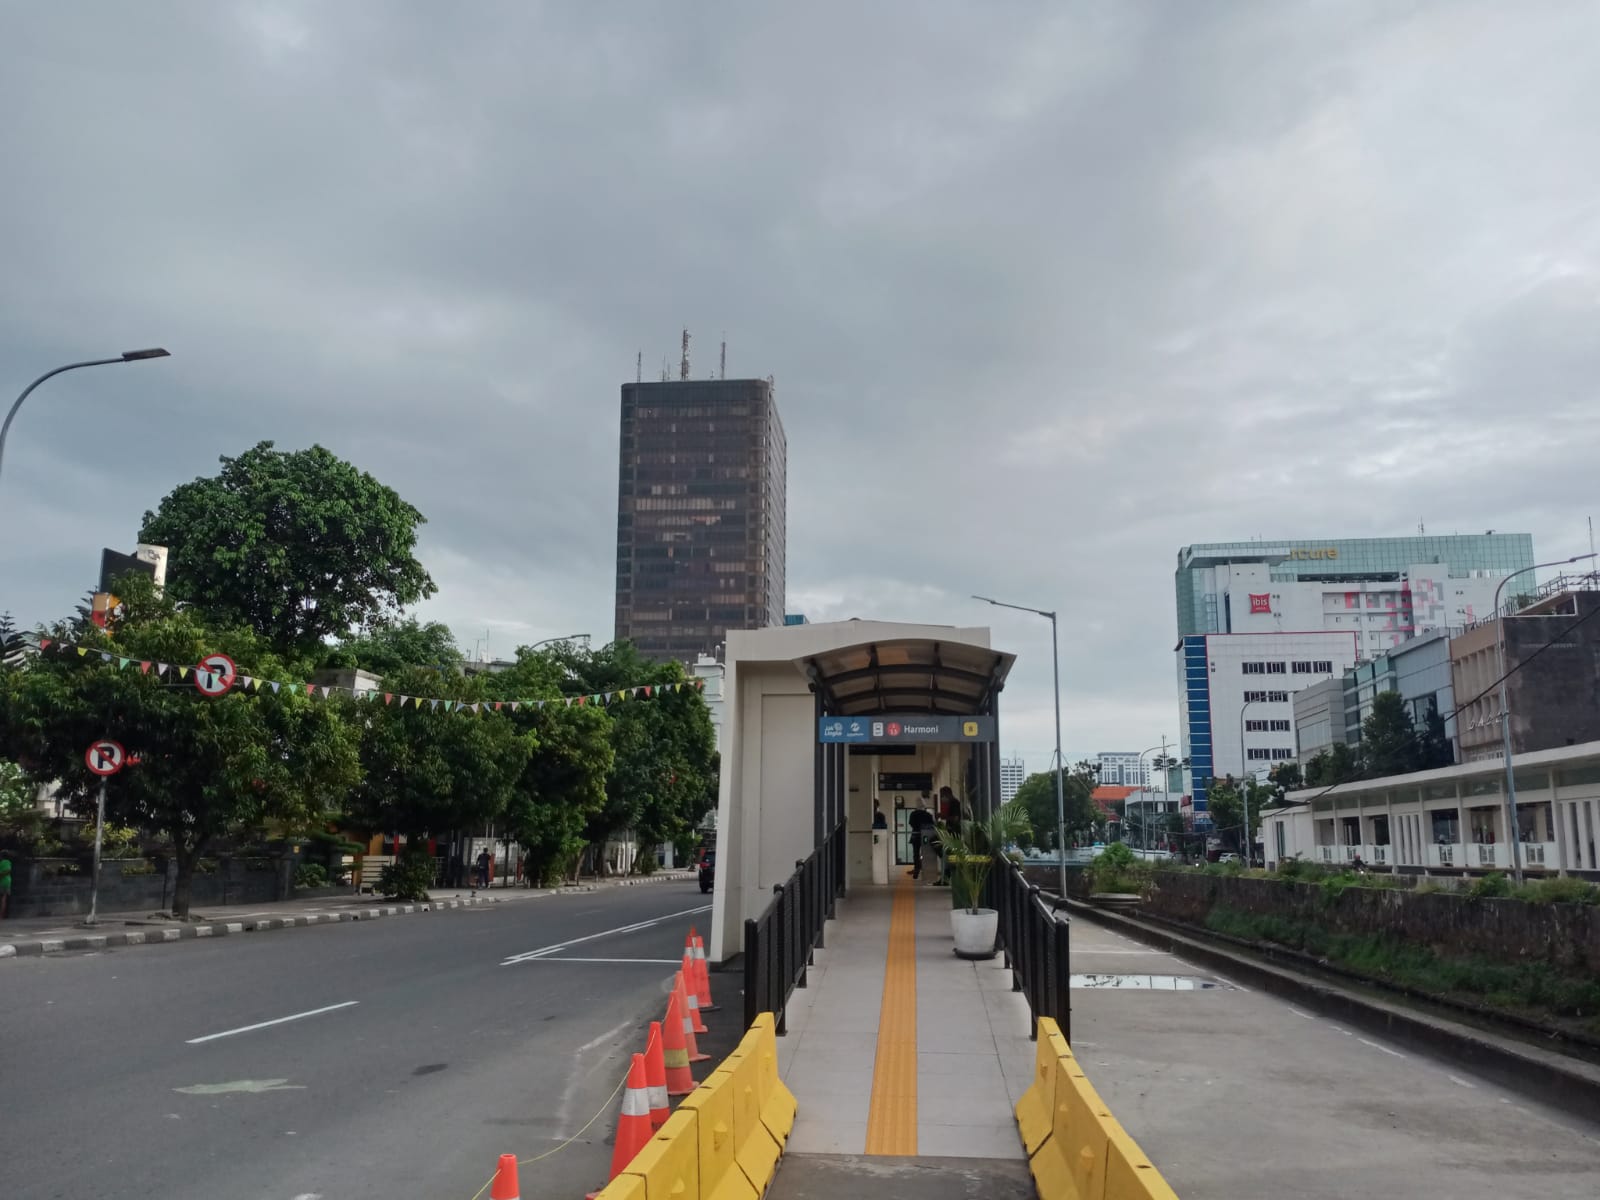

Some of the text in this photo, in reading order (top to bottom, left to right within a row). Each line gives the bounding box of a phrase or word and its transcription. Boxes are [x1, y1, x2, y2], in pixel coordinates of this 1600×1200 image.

[1284, 548, 1337, 561] rcure
[1253, 598, 1268, 606] ibis
[904, 725, 939, 734] Harmoni
